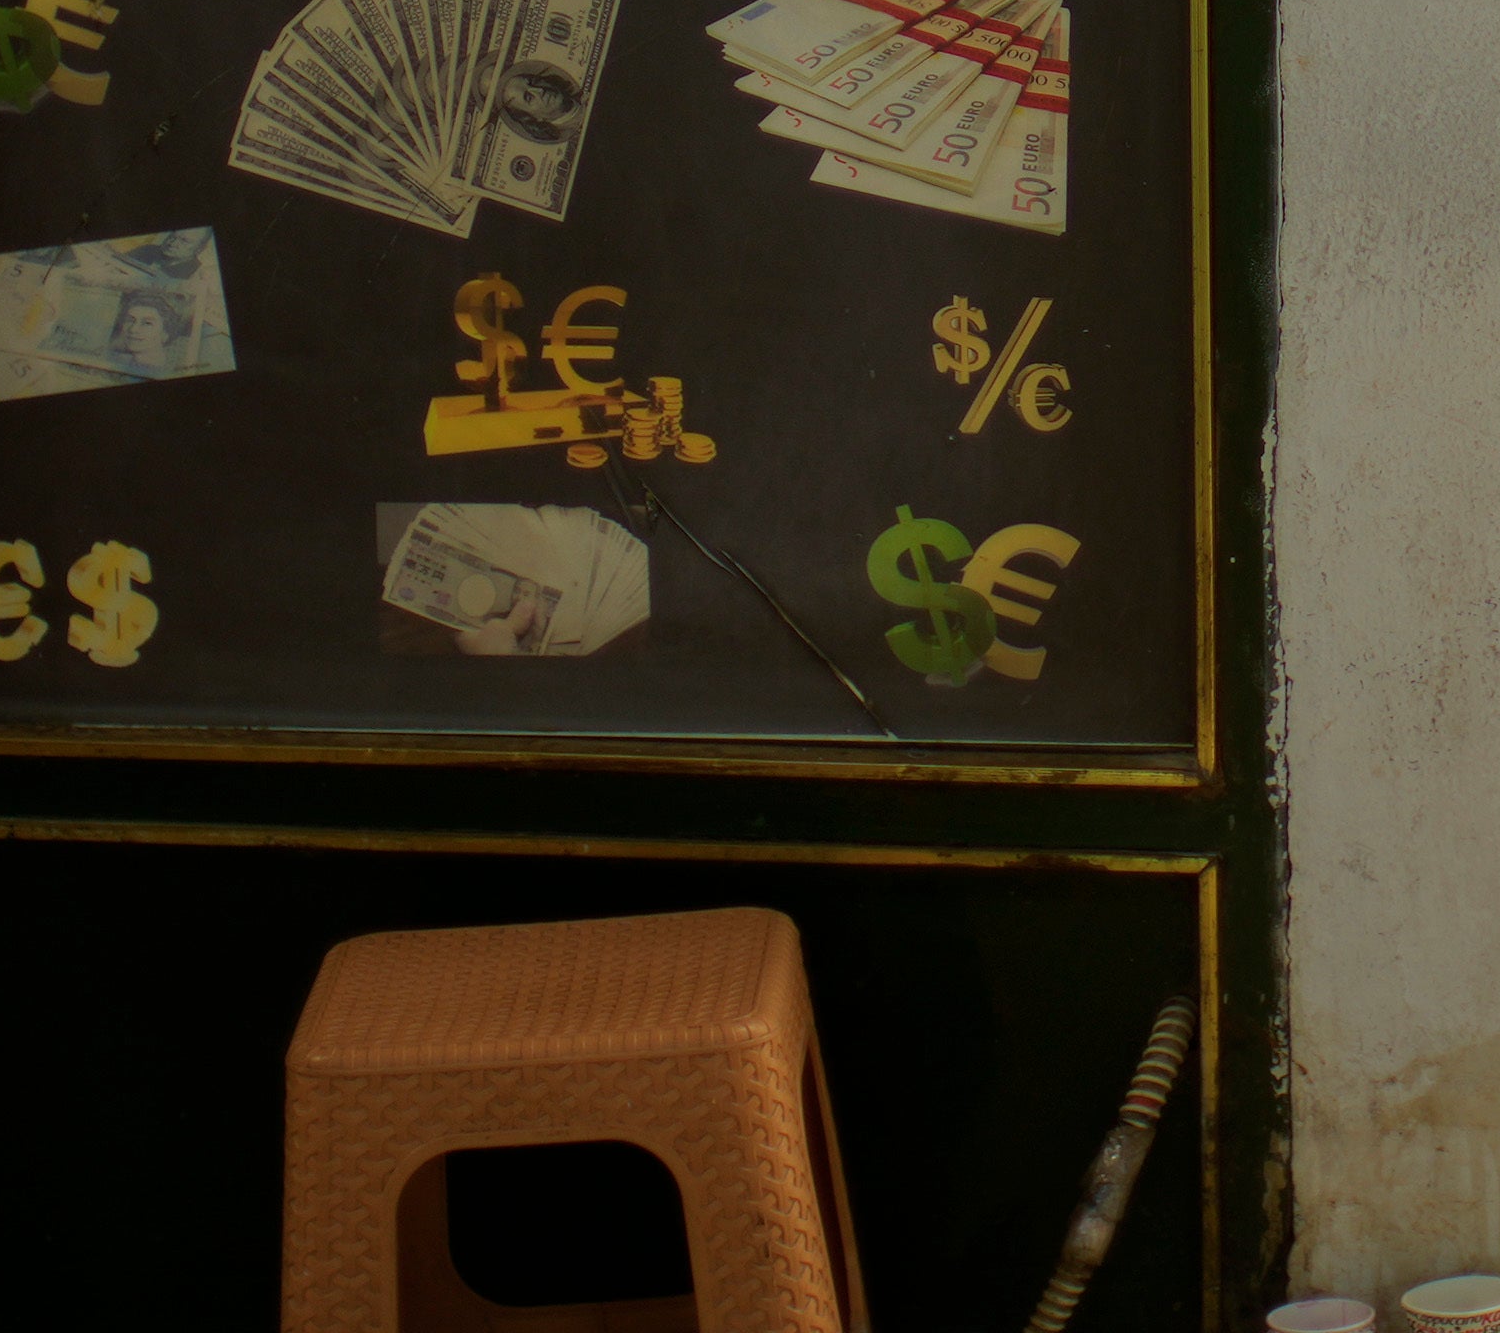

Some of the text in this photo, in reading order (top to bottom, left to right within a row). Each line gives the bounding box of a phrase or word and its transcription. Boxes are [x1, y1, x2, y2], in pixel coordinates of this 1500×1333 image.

[796, 45, 836, 69] 50
[829, 42, 904, 94] 50 EURO
[869, 73, 938, 133] 50 EURO
[933, 100, 984, 167] 50 EURO
[1012, 134, 1052, 215] 50 EURO
